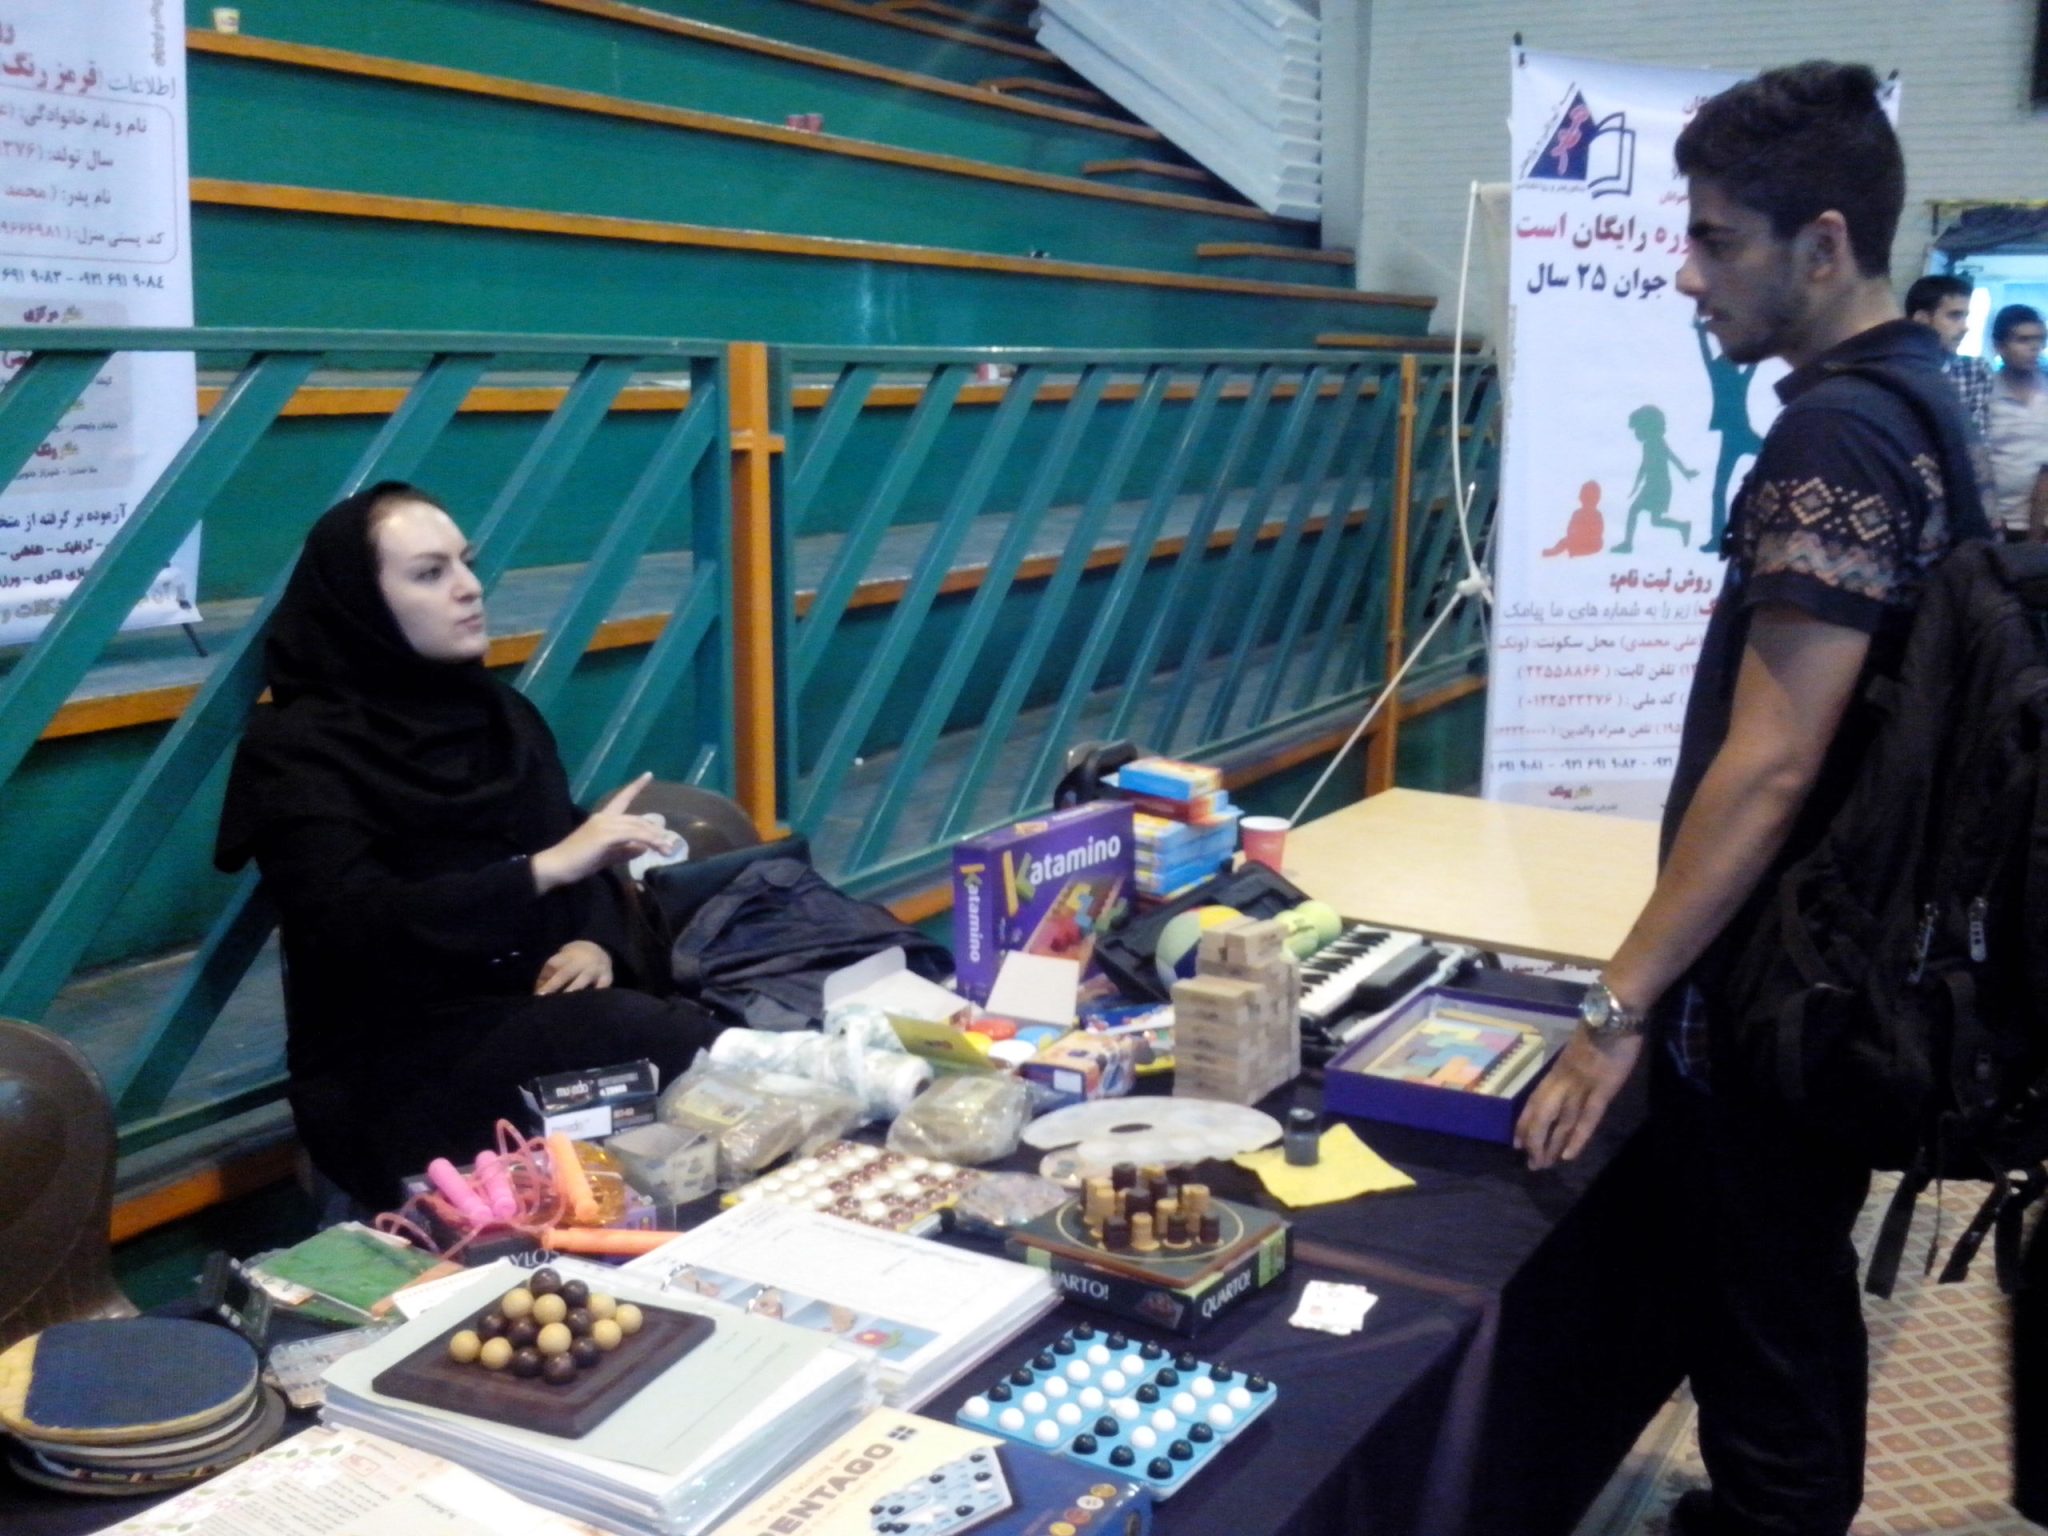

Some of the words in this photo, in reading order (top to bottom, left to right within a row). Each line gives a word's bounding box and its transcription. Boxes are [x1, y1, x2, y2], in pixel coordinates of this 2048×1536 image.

[108, 73, 175, 99] اطلاعات
[92, 113, 110, 130] نام
[114, 121, 122, 136] و
[126, 116, 147, 138] نام
[86, 149, 113, 171] سال
[94, 187, 111, 205] نام
[1516, 211, 1568, 239] است
[1572, 213, 1648, 252] رایگان
[1527, 262, 1569, 295] سال
[1576, 262, 1607, 292] ۲۵
[1613, 266, 1668, 300] جوان
[24, 513, 36, 533] از
[1642, 568, 1672, 593] ثبت
[1674, 569, 1713, 594] روش
[1503, 600, 1545, 624] پیامک
[1549, 601, 1565, 618] ما
[1568, 601, 1600, 620] های
[1602, 601, 1641, 620] شماره
[1002, 835, 1121, 918] Katamino
[959, 863, 986, 963] Katamino
[509, 1248, 560, 1268] YLO
[1055, 1272, 1109, 1300] ARTO!
[1201, 1269, 1252, 1319] QUARTO!
[757, 1442, 894, 1536] ENTAGO
